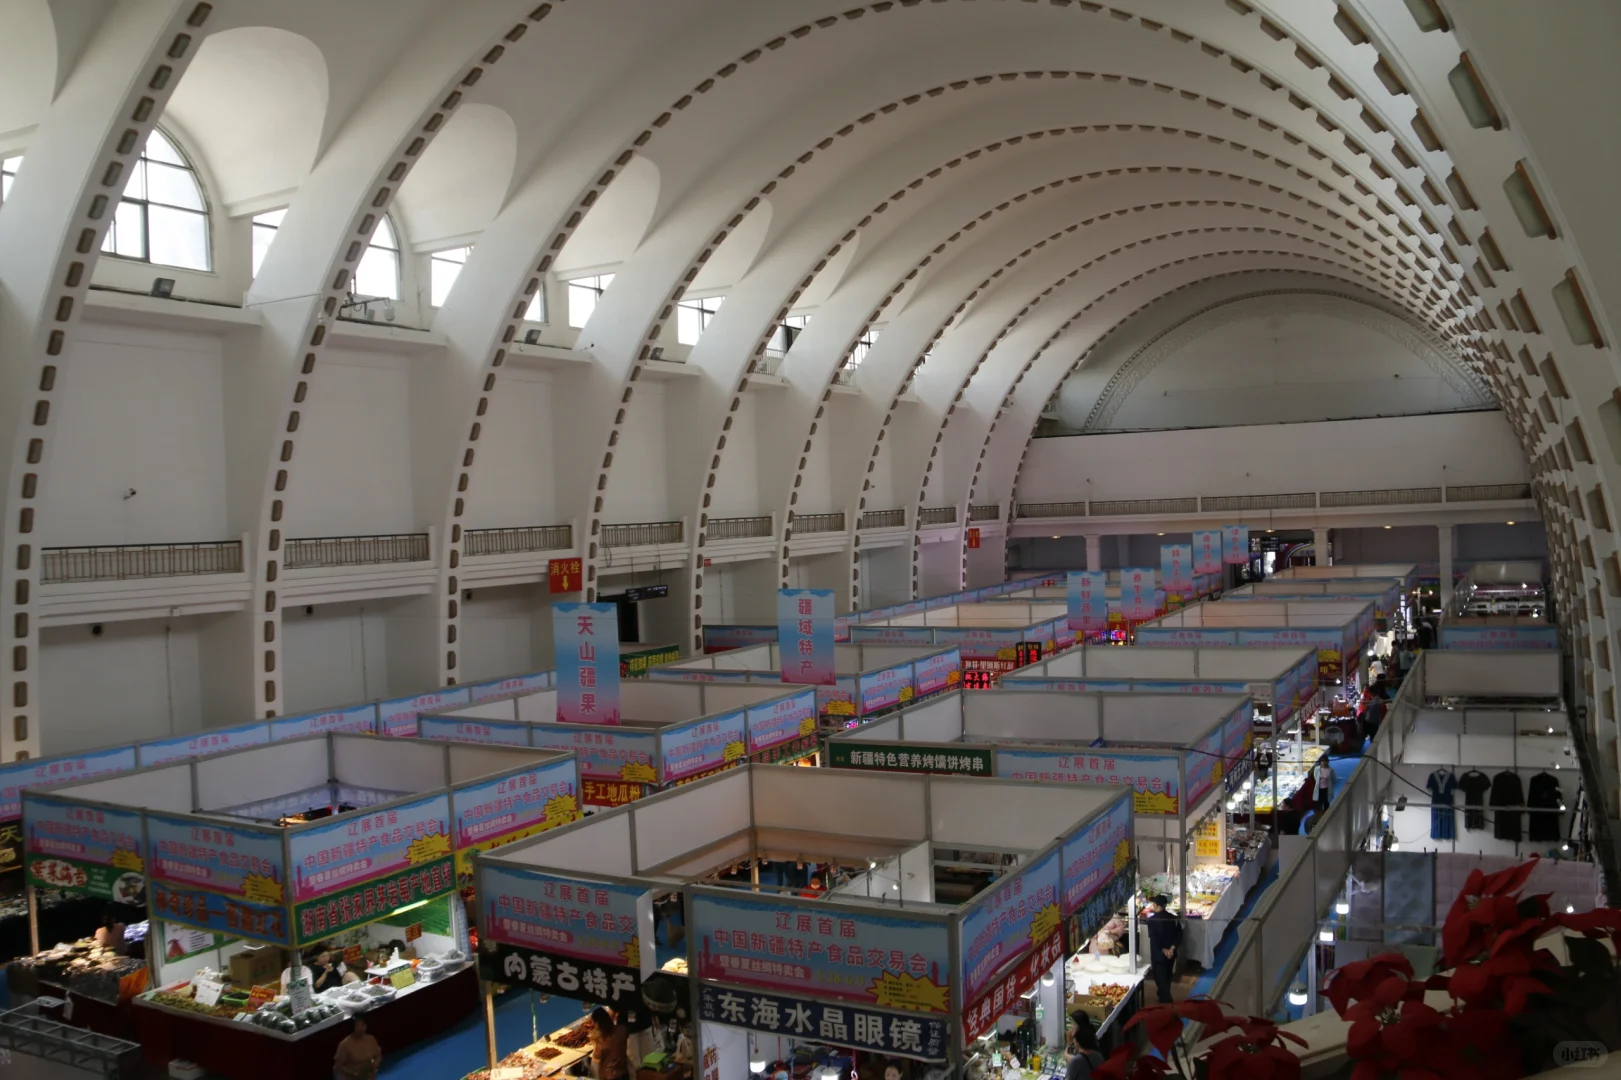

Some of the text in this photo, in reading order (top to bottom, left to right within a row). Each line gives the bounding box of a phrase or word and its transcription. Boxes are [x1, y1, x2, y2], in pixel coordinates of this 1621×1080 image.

[550, 561, 581, 576] 消火栓
[798, 599, 813, 675] 疆域特产
[577, 616, 597, 714] 天山疆果
[1057, 757, 1116, 771] 辽展首届
[497, 773, 537, 795] 辽展首届
[584, 781, 641, 803] 手工地瓜粉
[463, 780, 568, 822] 中国新疆特产食品交易会
[347, 810, 398, 837] 辽展首届
[304, 818, 438, 869] 中国新疆特产食品交易会
[542, 881, 610, 907] 辽展首届
[775, 911, 857, 939] 辽展首届
[713, 927, 930, 974] 中国新疆特产食品交易会
[503, 951, 637, 1002] 内蒙古特产
[718, 953, 806, 980] 暨春夏丝绸特卖会
[717, 991, 923, 1053] 东海水晶眼镜
